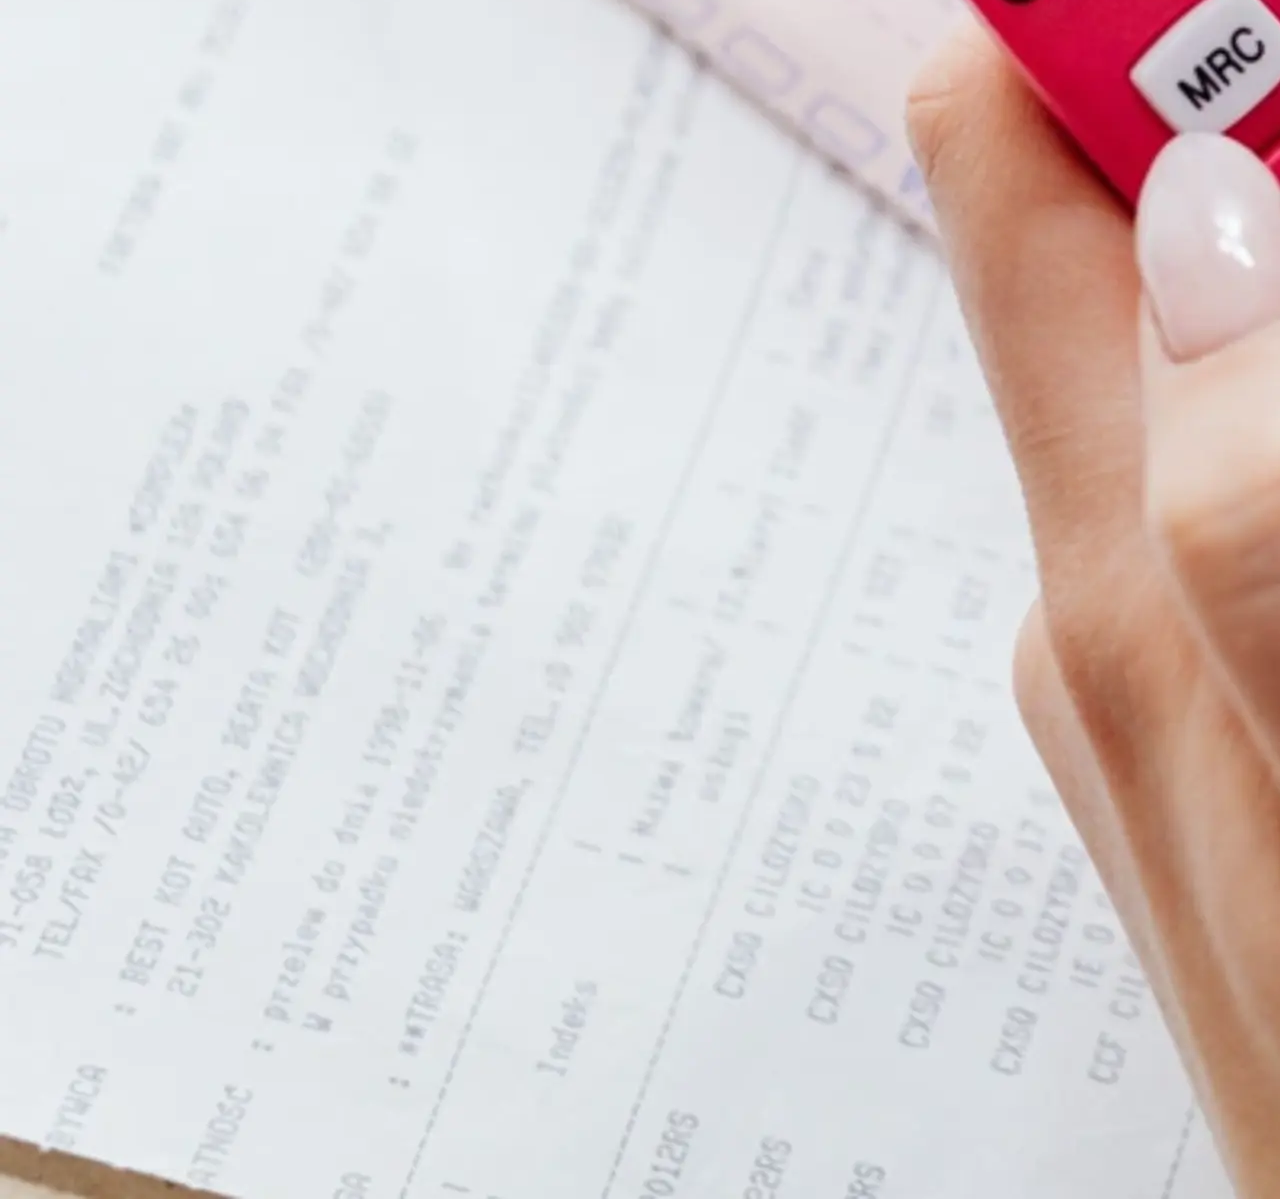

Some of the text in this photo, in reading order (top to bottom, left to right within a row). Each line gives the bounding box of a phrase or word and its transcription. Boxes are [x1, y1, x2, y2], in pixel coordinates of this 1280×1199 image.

[1177, 27, 1265, 110] MRC
[33, 849, 103, 959] TEL/FAX
[119, 920, 168, 986] BEST
[154, 855, 195, 907] KOT
[167, 897, 231, 997] 21-302
[264, 908, 325, 1023] przelew
[311, 860, 346, 893] do
[536, 982, 597, 1077] Indeks
